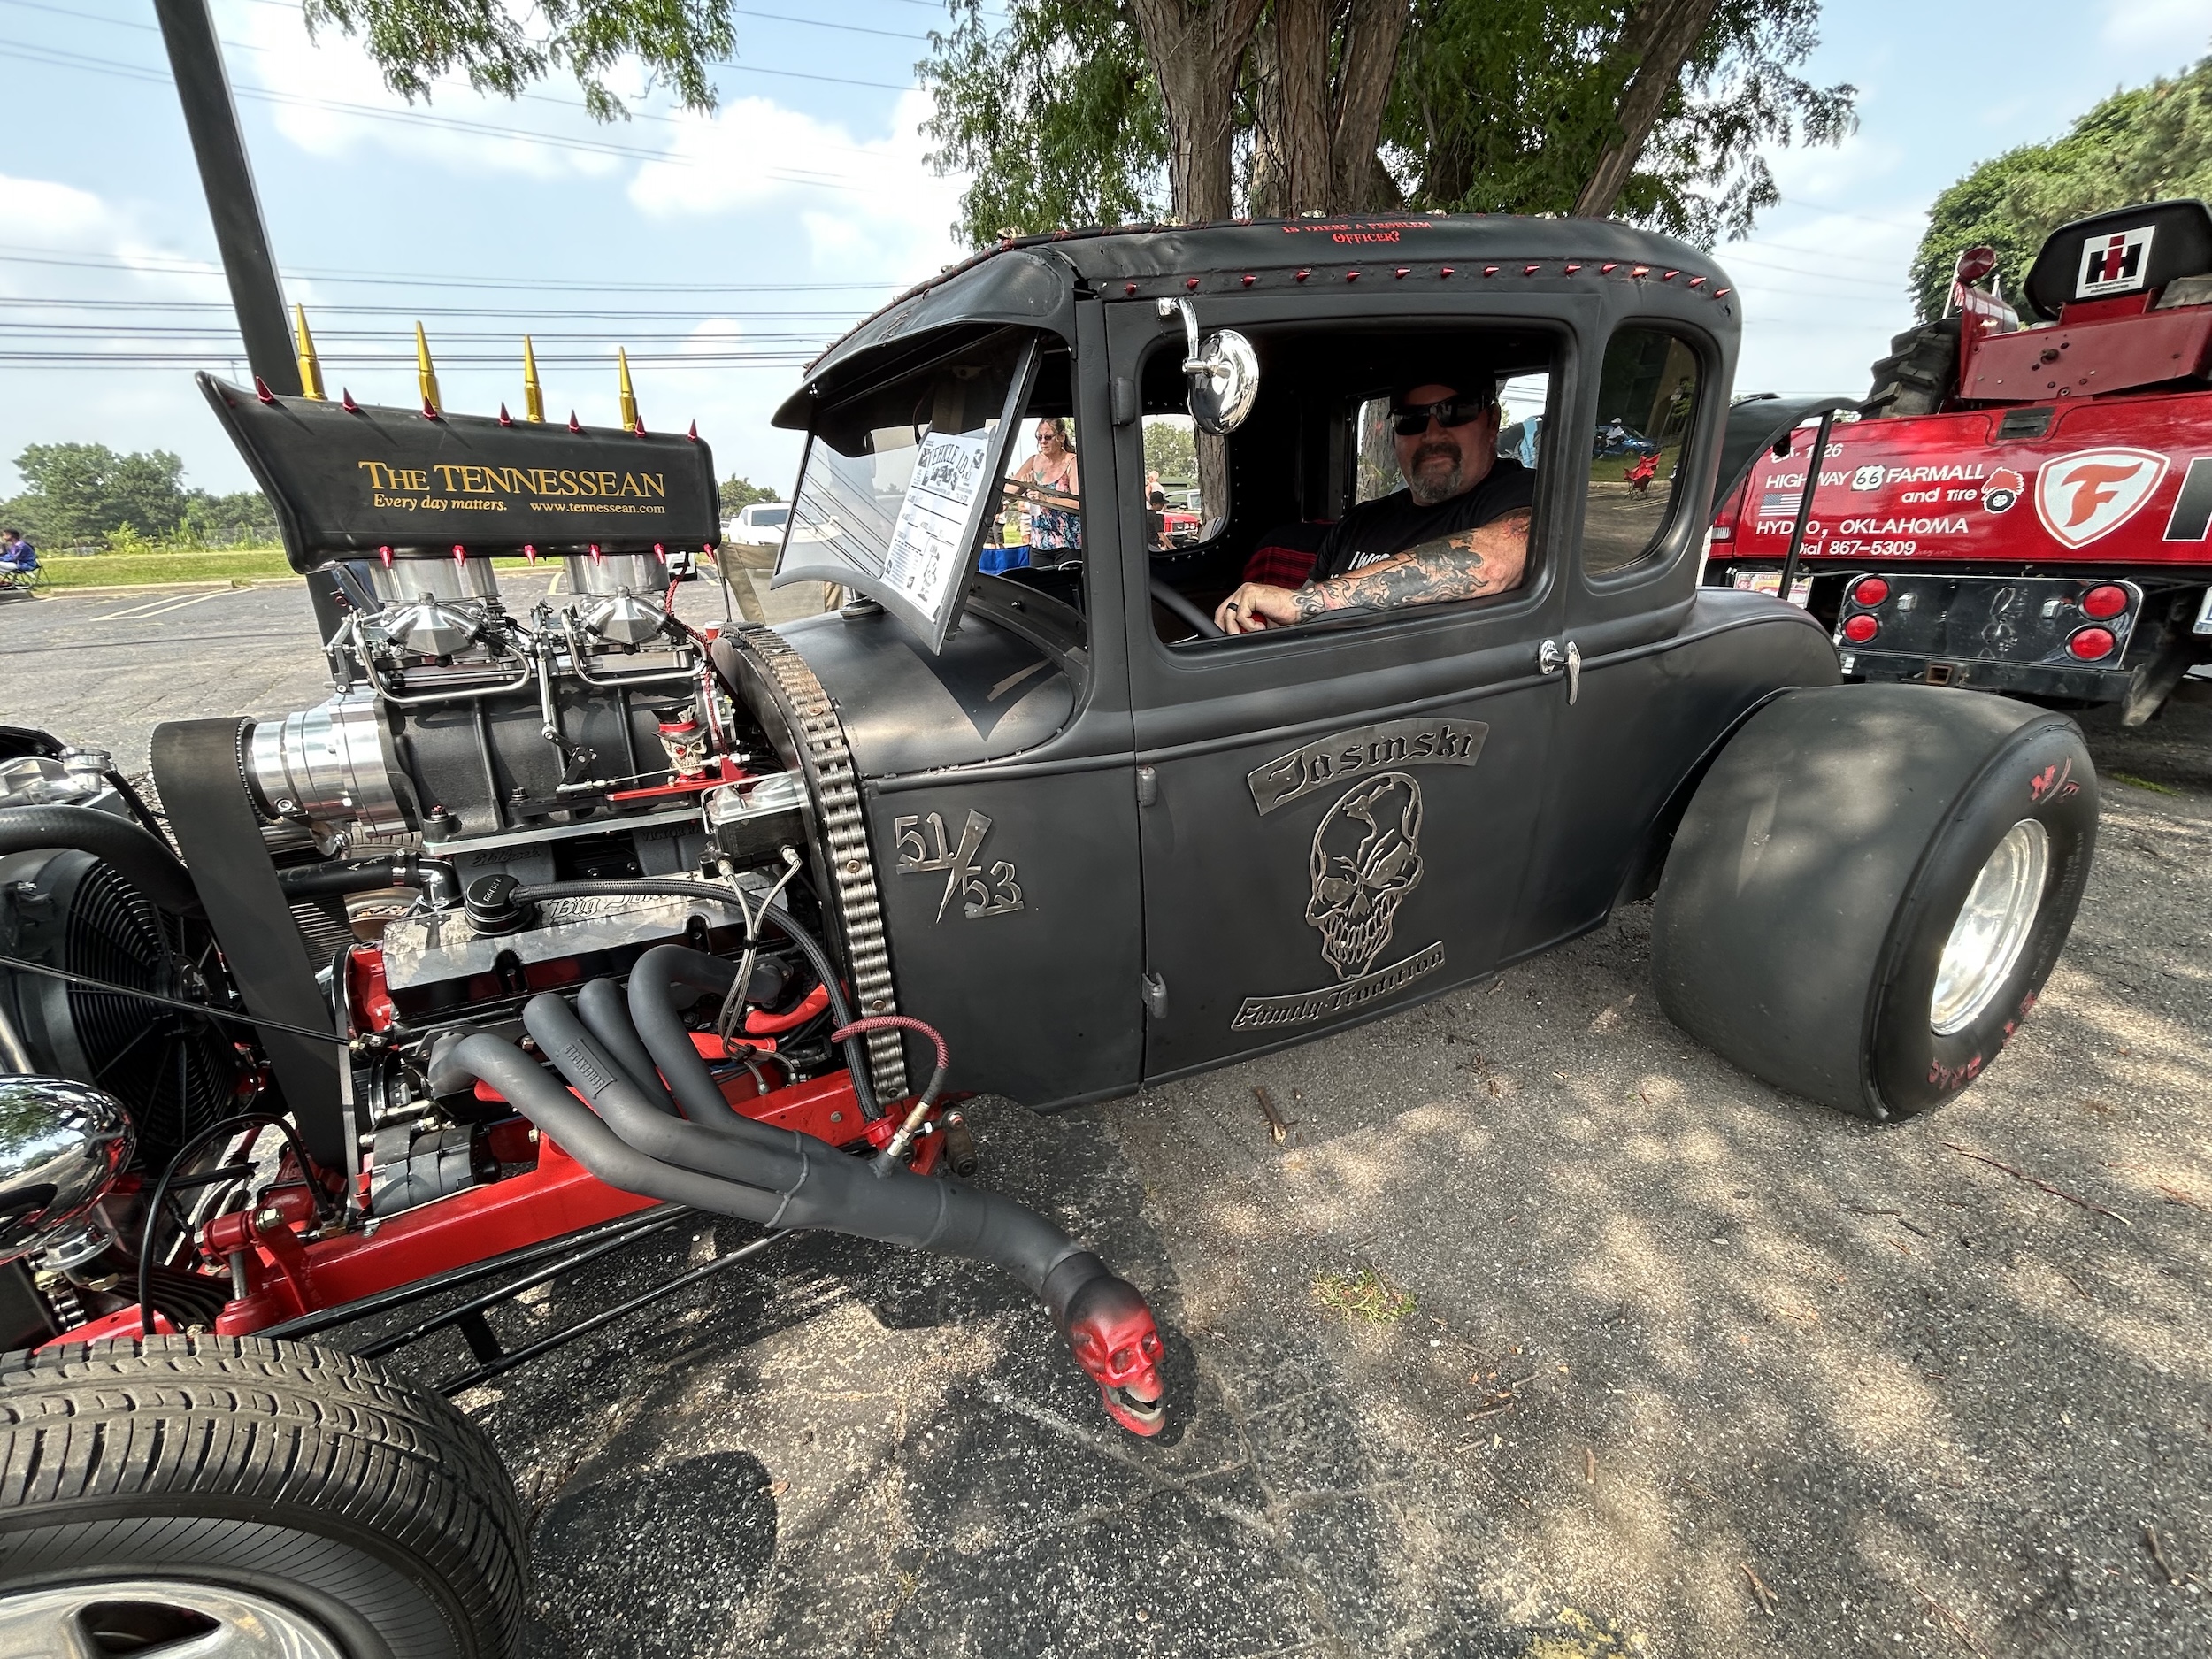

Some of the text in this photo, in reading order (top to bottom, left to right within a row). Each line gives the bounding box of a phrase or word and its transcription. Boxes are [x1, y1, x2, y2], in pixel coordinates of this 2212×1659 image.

[927, 443, 960, 469] VEHICLE
[1805, 443, 1844, 459] 126
[433, 465, 665, 498] TENNESSEAN
[1856, 472, 1880, 485] 66
[1886, 464, 1985, 483] FARMALL
[373, 493, 665, 514] Every day matters. www.tennessean.com
[1901, 487, 1939, 503] and
[1755, 518, 1970, 539] HYDO, OKLAHOMA
[1829, 540, 1916, 557] 867-5309
[1268, 724, 1474, 803] Jasinski
[547, 895, 601, 918] Big
